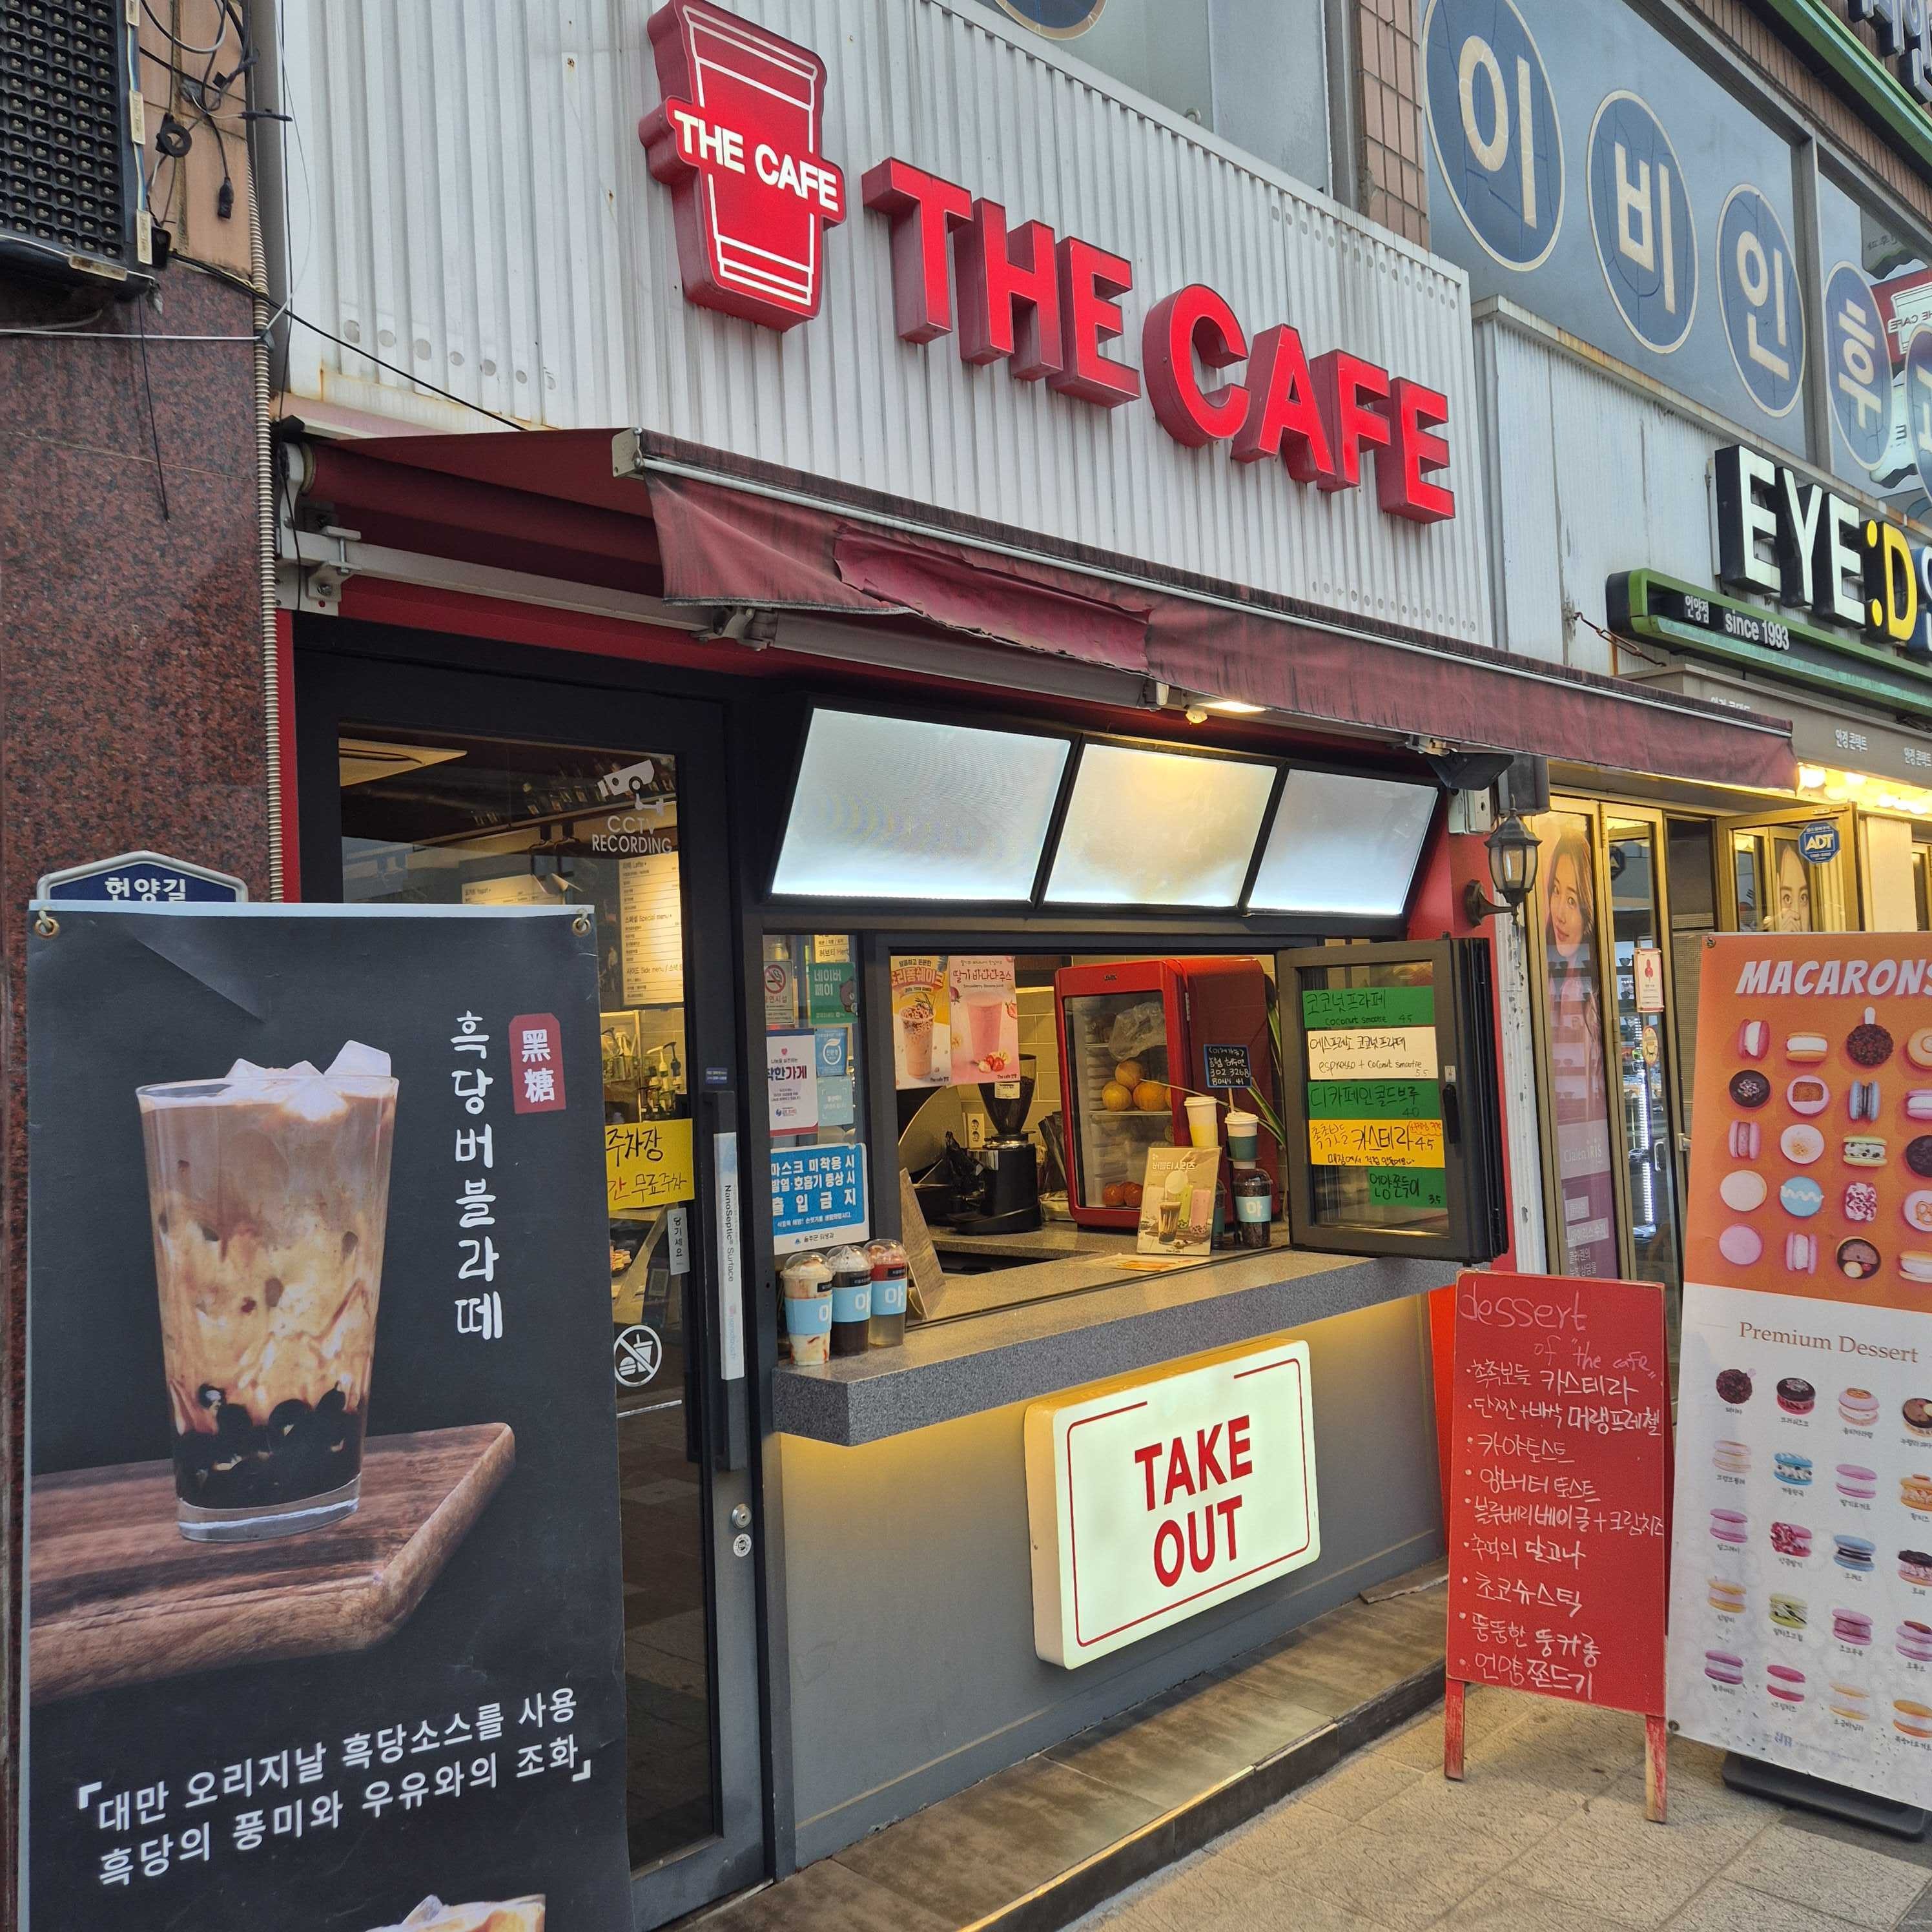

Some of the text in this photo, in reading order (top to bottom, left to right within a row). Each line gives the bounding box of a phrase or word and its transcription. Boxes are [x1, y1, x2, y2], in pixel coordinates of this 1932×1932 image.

[674, 109, 839, 212] THE CAFE
[865, 156, 1455, 523] THE CAFE
[1685, 595, 1789, 650] 언양점 since 1993
[1835, 728, 1848, 749] 안경
[608, 816, 656, 835] CCTV
[592, 834, 672, 854] RECORDING
[1805, 833, 1834, 850] ADT
[105, 877, 186, 902] 헌양길
[814, 969, 841, 982] 네이버
[815, 983, 833, 996] 페이
[952, 969, 971, 983] 딸기
[1325, 1015, 1357, 1025] coconut
[1310, 1036, 1355, 1054] 에스프레소
[522, 1029, 555, 1103] 黑糖
[1319, 1061, 1356, 1076] espresso
[606, 1126, 664, 1167] 주차장
[451, 1011, 503, 1340] 흑당버블라떼
[771, 1155, 855, 1177] 마스크 미착용 시
[825, 1172, 843, 1187] 증상
[847, 1170, 856, 1184] 시
[1457, 1281, 1588, 1331] dessert
[1534, 1335, 1561, 1366] of
[1739, 1321, 1919, 1363] Premium Dessert
[1540, 1369, 1639, 1405] 카스테라
[1135, 1414, 1253, 1512] TAKE
[1477, 1434, 1576, 1463] 카야토스트
[1554, 1476, 1601, 1503] 토스트
[1154, 1494, 1243, 1588] OUT
[1470, 1533, 1587, 1570] 추억의 달고나
[1475, 1572, 1583, 1618] 초코슈스틱
[185, 1741, 326, 1809] 오리지날
[342, 1701, 505, 1769] 흑당소스를
[517, 1687, 577, 1729] 사용
[99, 1822, 211, 1886] 흑당의
[232, 1791, 344, 1851] 풍미와
[362, 1752, 497, 1817] 우유와의
